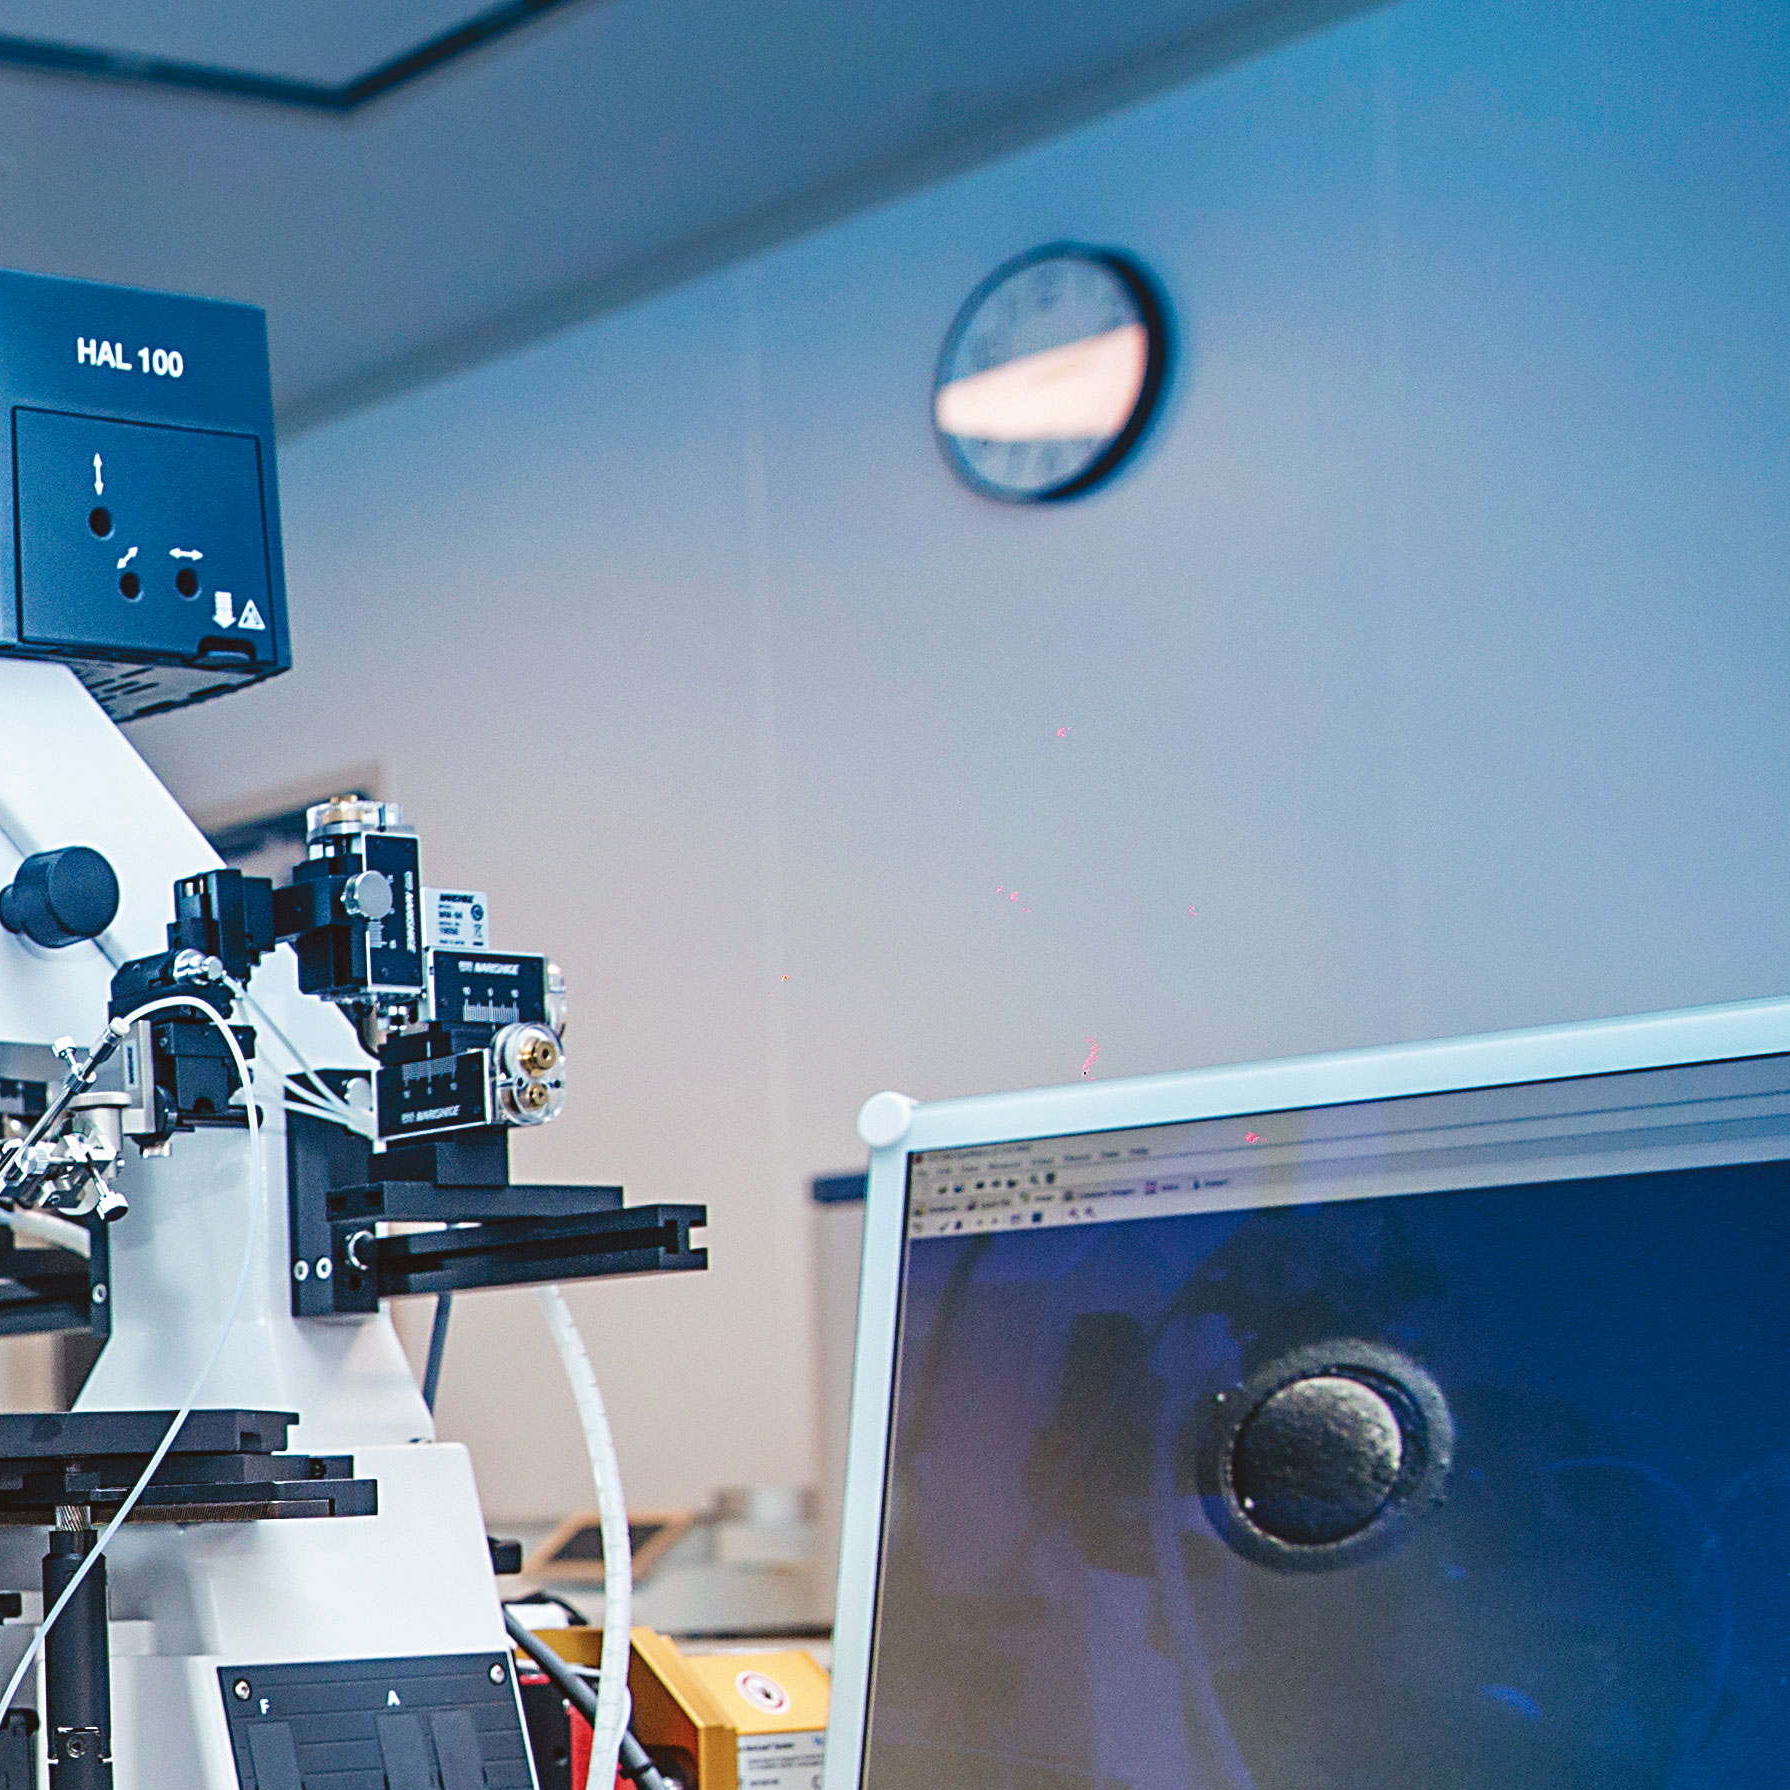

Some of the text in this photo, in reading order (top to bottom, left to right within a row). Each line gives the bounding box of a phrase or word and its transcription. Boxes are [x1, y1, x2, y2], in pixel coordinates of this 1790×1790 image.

[77, 336, 184, 378] HAL 100
[387, 1689, 401, 1706] A
[259, 1698, 270, 1715] F
